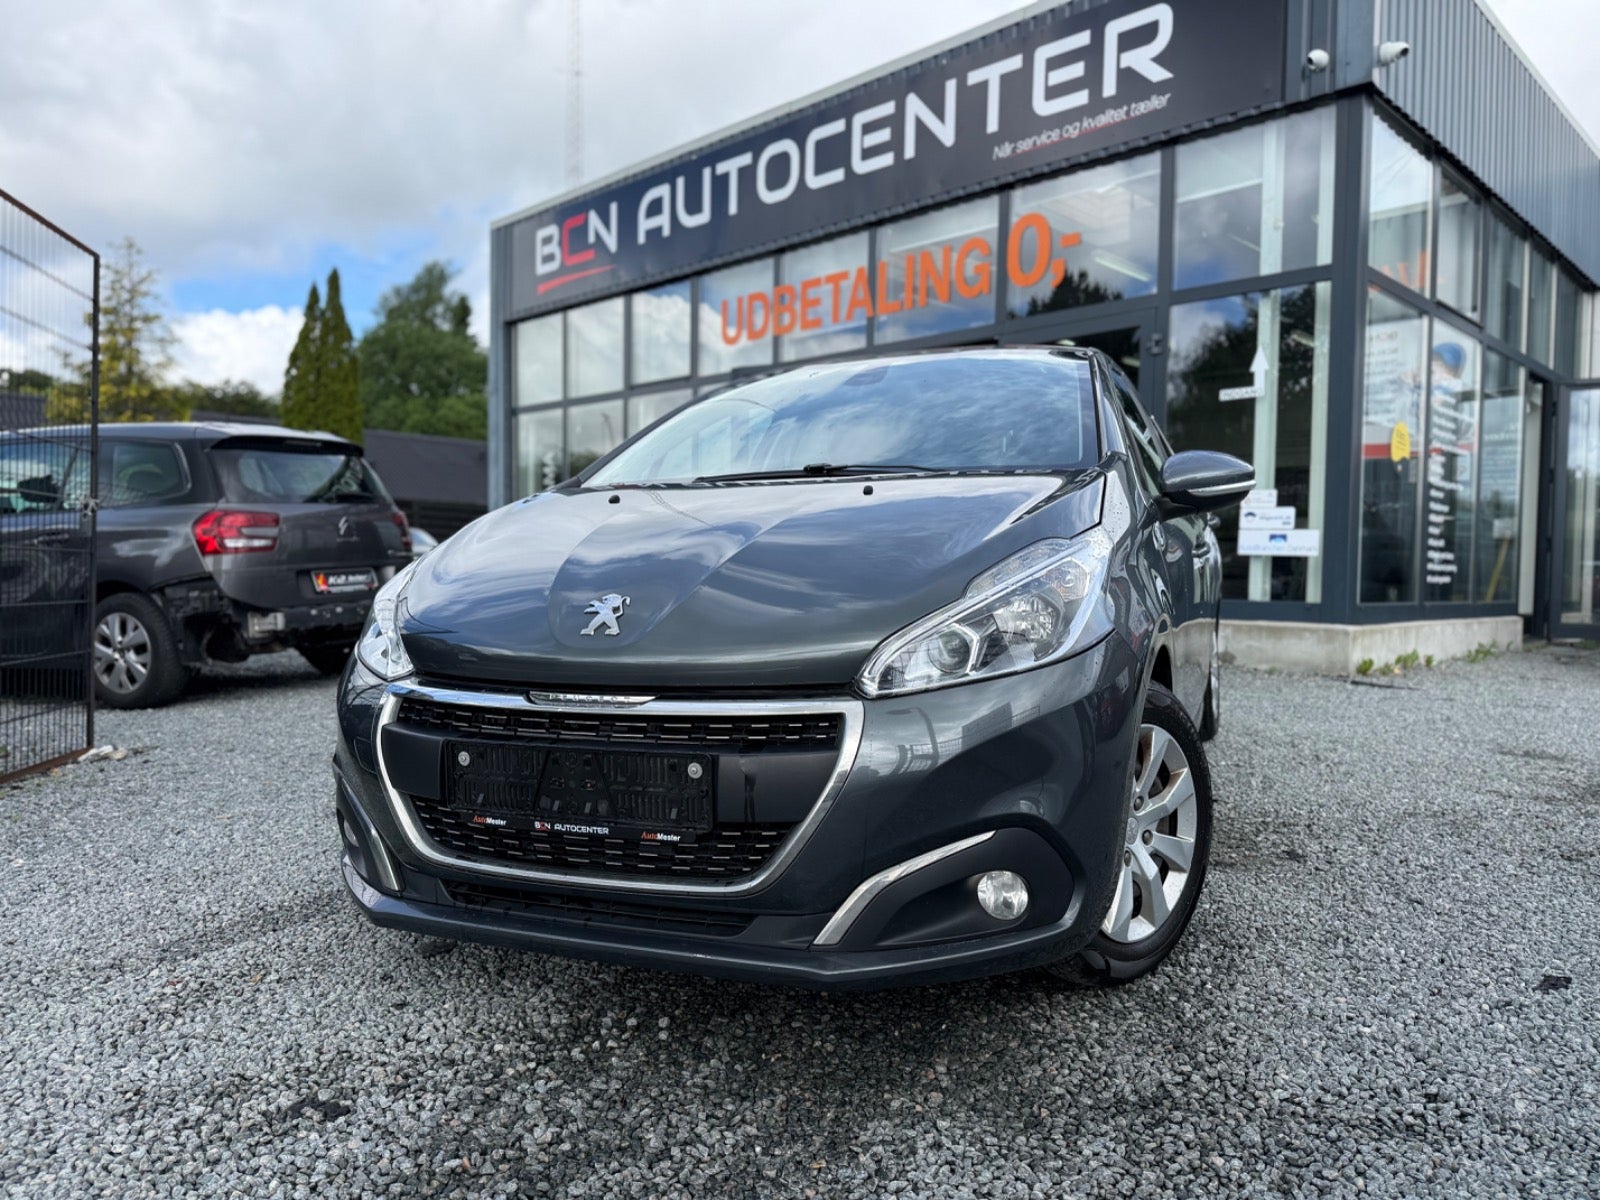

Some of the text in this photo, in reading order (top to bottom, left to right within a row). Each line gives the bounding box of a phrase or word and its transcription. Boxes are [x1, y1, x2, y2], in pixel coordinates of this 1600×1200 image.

[535, 2, 1174, 276] BCN AUTOCENTER
[1015, 128, 1060, 153] service
[1061, 121, 1081, 138] og
[1081, 105, 1128, 130] kvalitet
[721, 237, 992, 346] UDBETALING
[554, 823, 610, 835] AUTOCENTER
[641, 831, 681, 842] AutoMester
